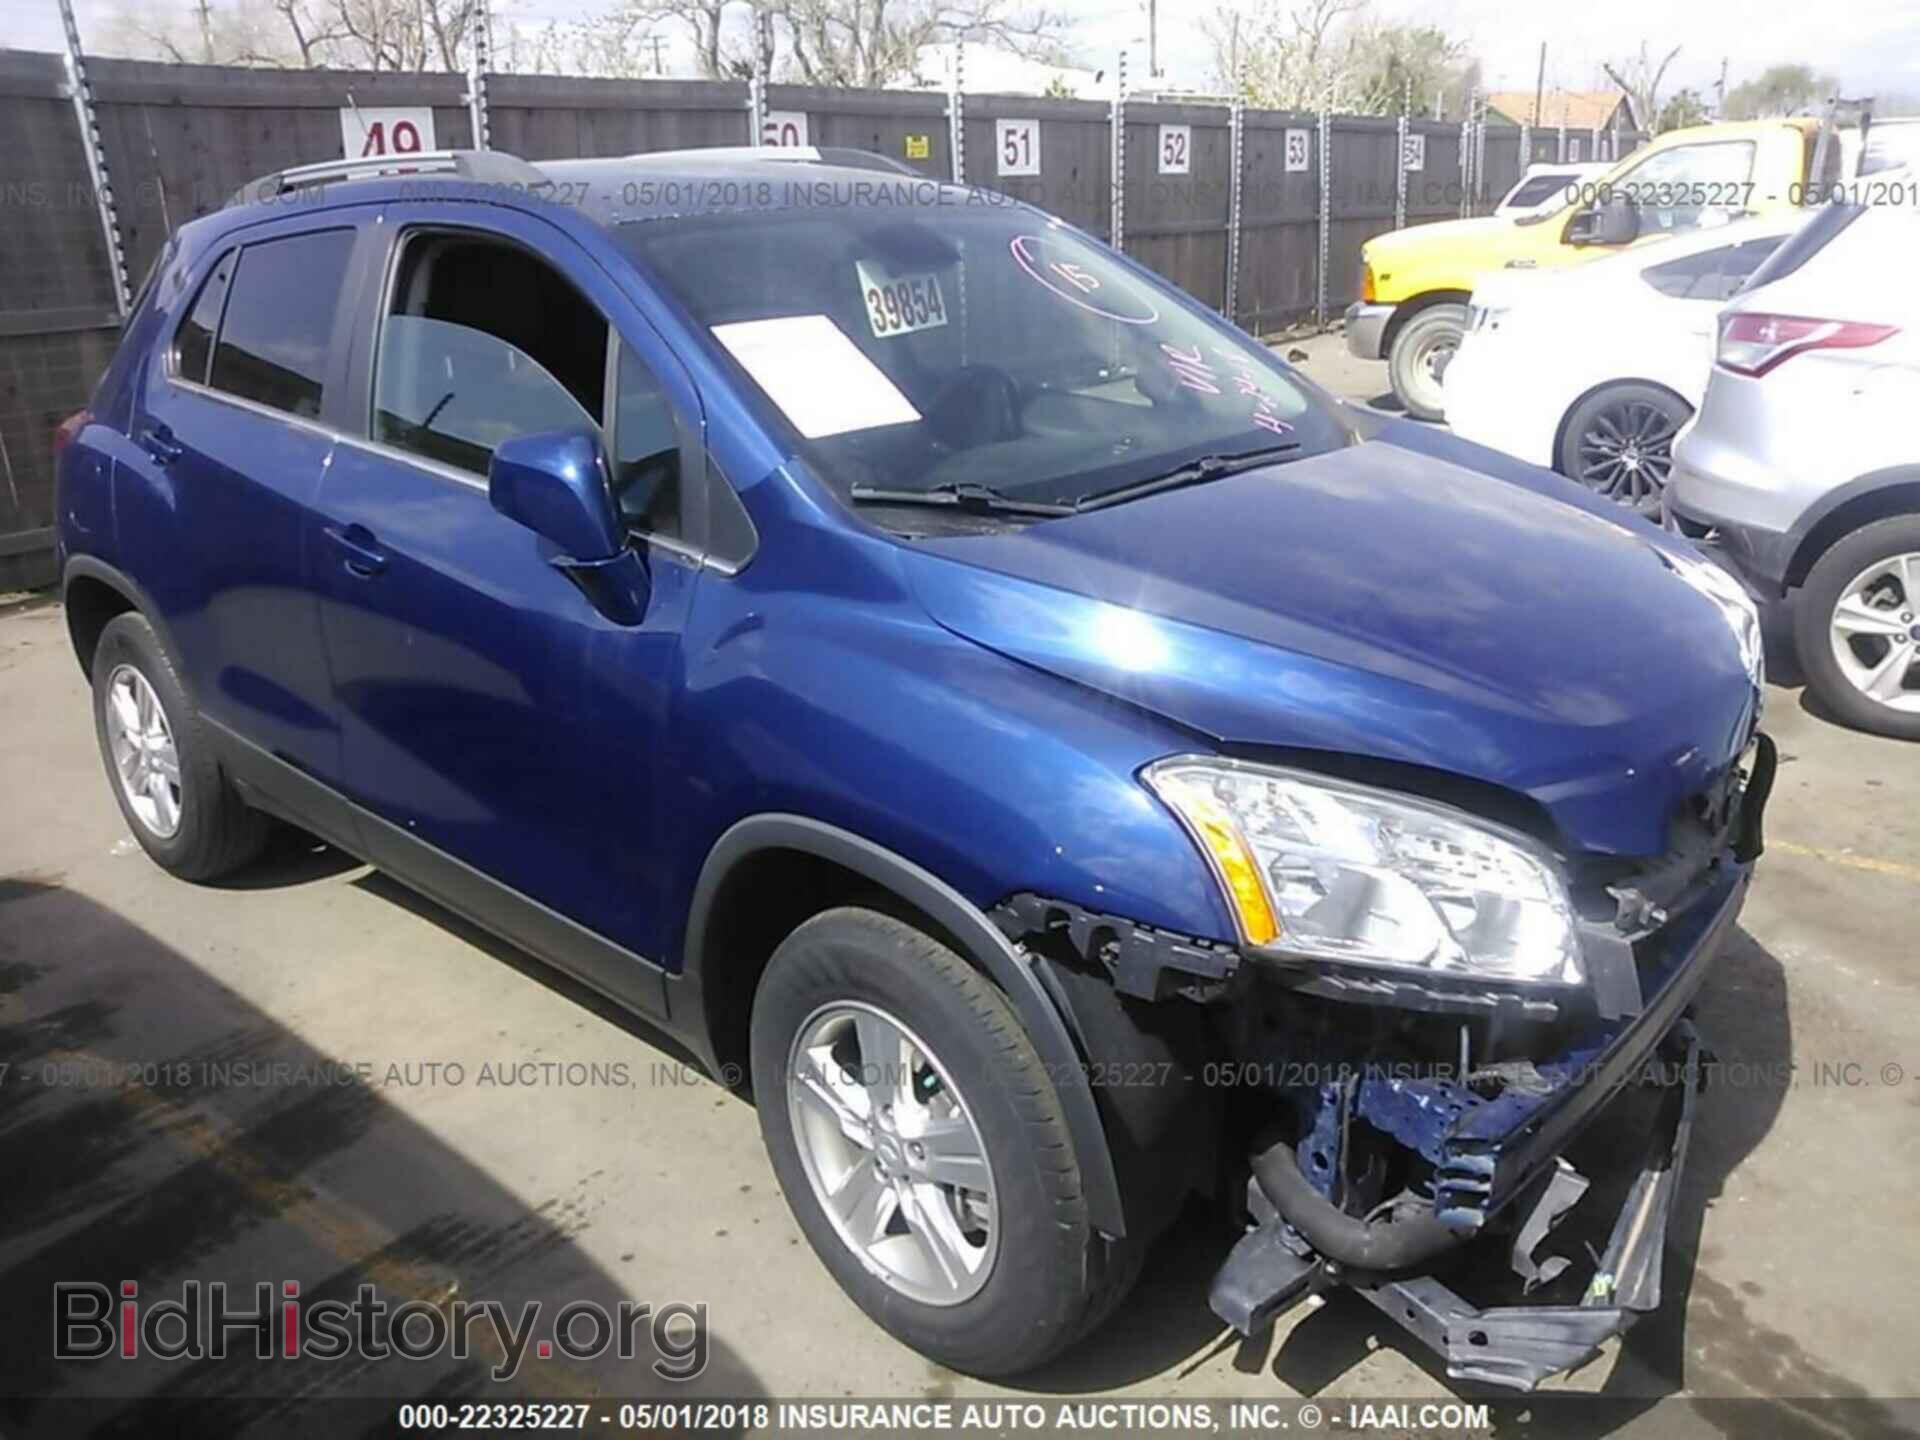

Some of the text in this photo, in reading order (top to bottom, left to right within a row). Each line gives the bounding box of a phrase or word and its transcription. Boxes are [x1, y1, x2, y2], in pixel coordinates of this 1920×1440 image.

[1004, 128, 1030, 166] 51
[1163, 132, 1185, 165] 52
[1289, 135, 1304, 164] 53
[1050, 262, 1100, 293] 15
[868, 279, 943, 333] 39854
